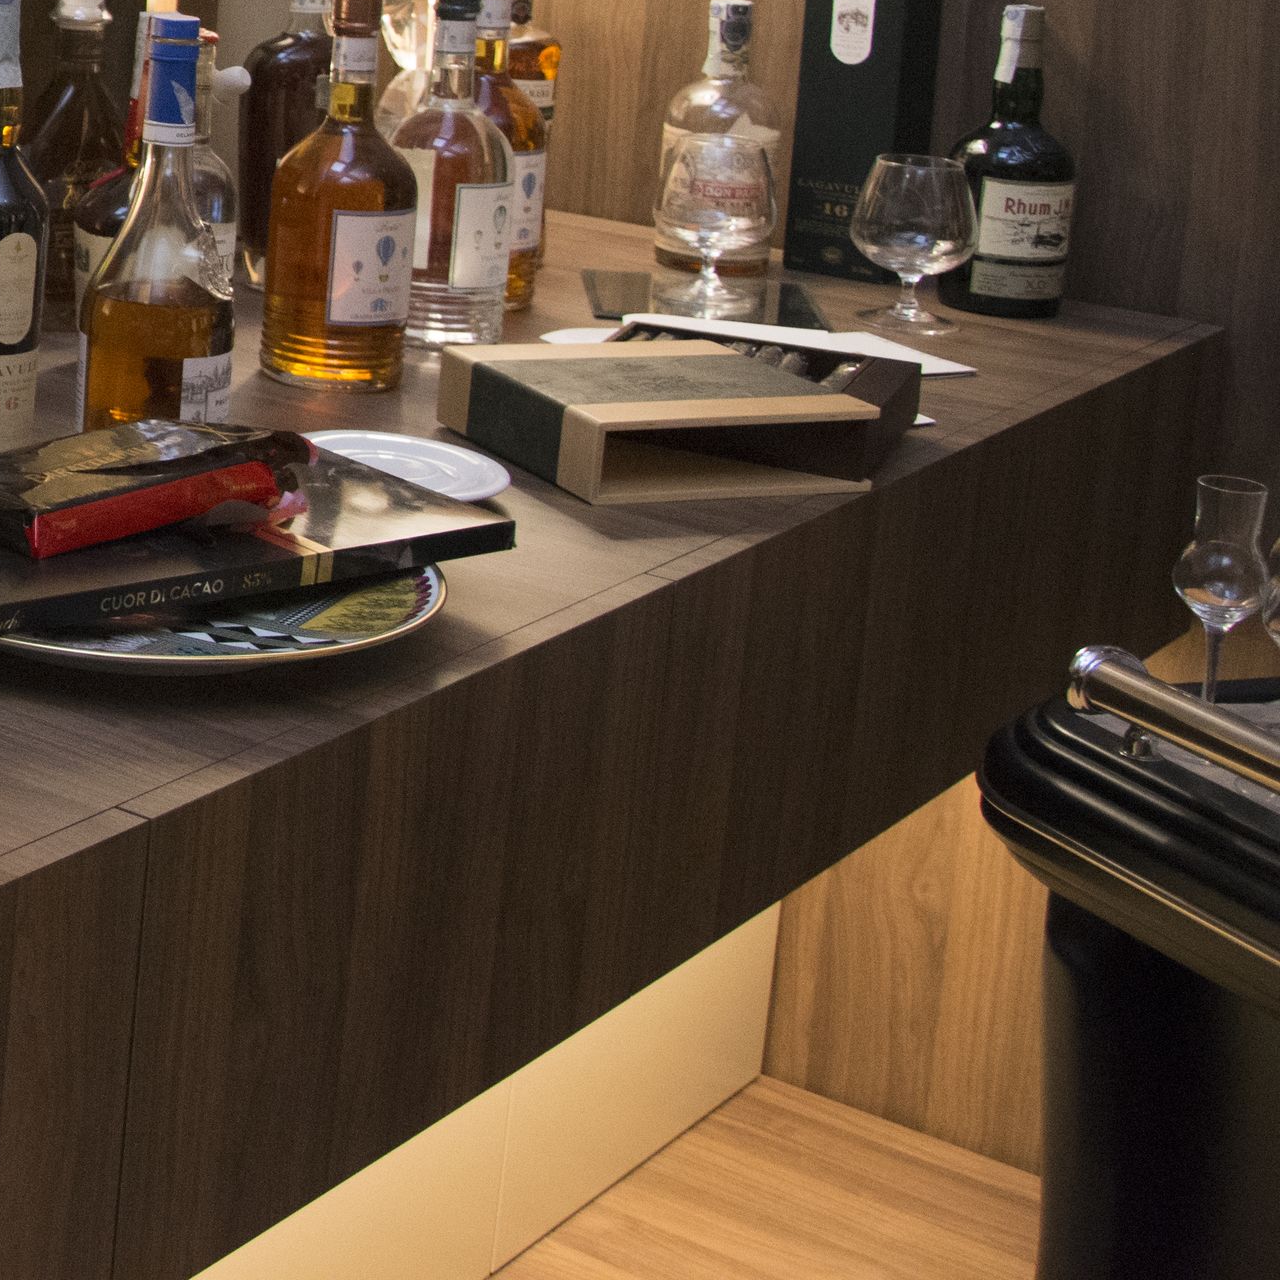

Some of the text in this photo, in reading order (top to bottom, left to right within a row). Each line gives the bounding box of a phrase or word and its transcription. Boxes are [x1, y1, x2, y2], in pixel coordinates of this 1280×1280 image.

[1004, 197, 1051, 215] Rhum
[99, 589, 146, 613] CUOR
[149, 588, 166, 606] DI
[169, 578, 224, 601] CACAO
